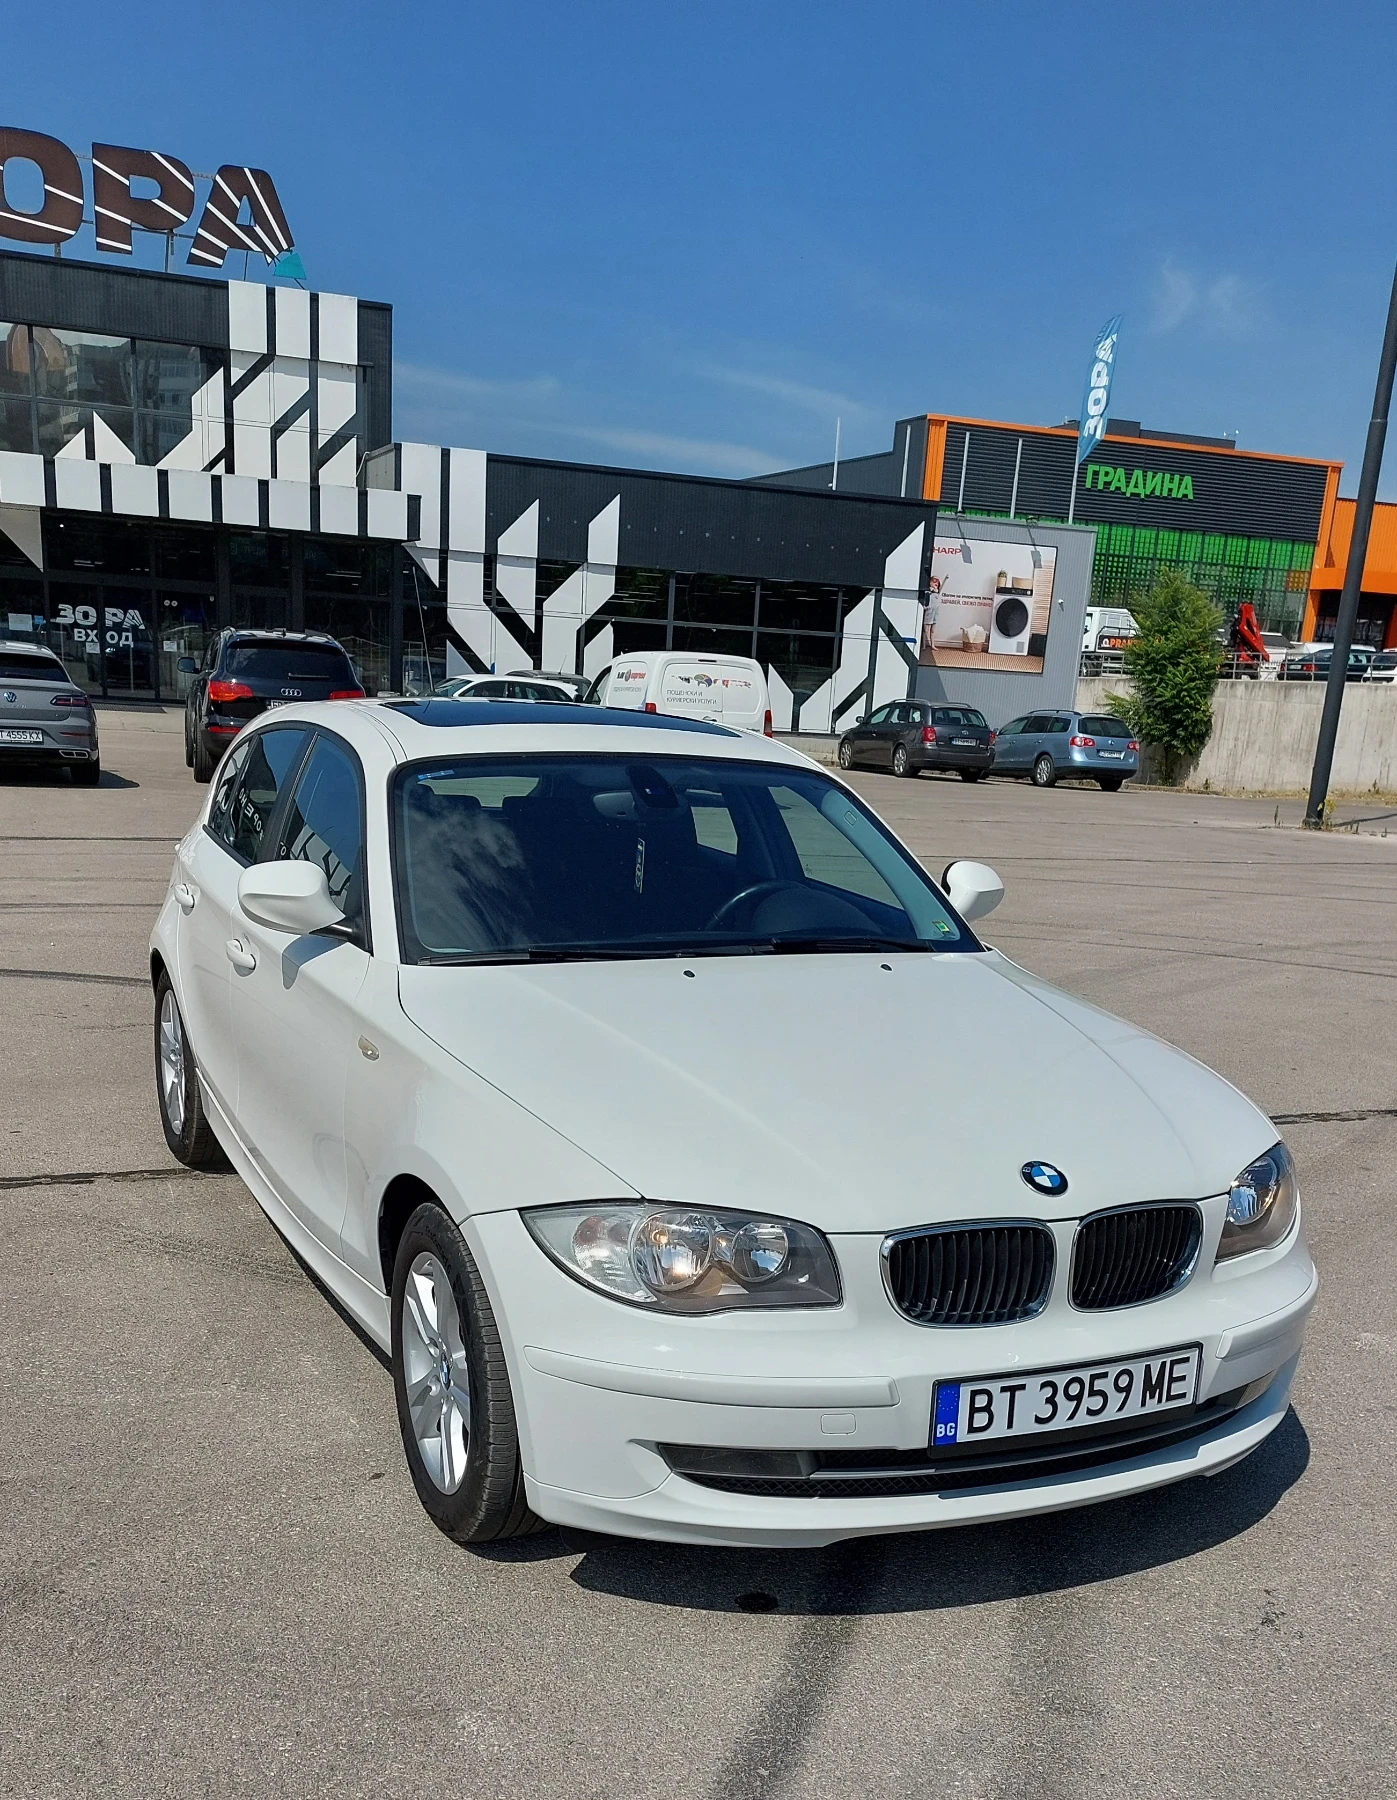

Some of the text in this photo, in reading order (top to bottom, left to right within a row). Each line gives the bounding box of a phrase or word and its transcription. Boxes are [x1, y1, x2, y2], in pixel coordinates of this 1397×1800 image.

[1083, 333, 1118, 440] ЗОРА
[1085, 464, 1194, 500] ГРАДИНА
[6, 730, 28, 739] 4555
[29, 731, 41, 740] KX
[966, 1356, 1191, 1435] BT 3959 ME
[936, 1422, 956, 1438] BG
